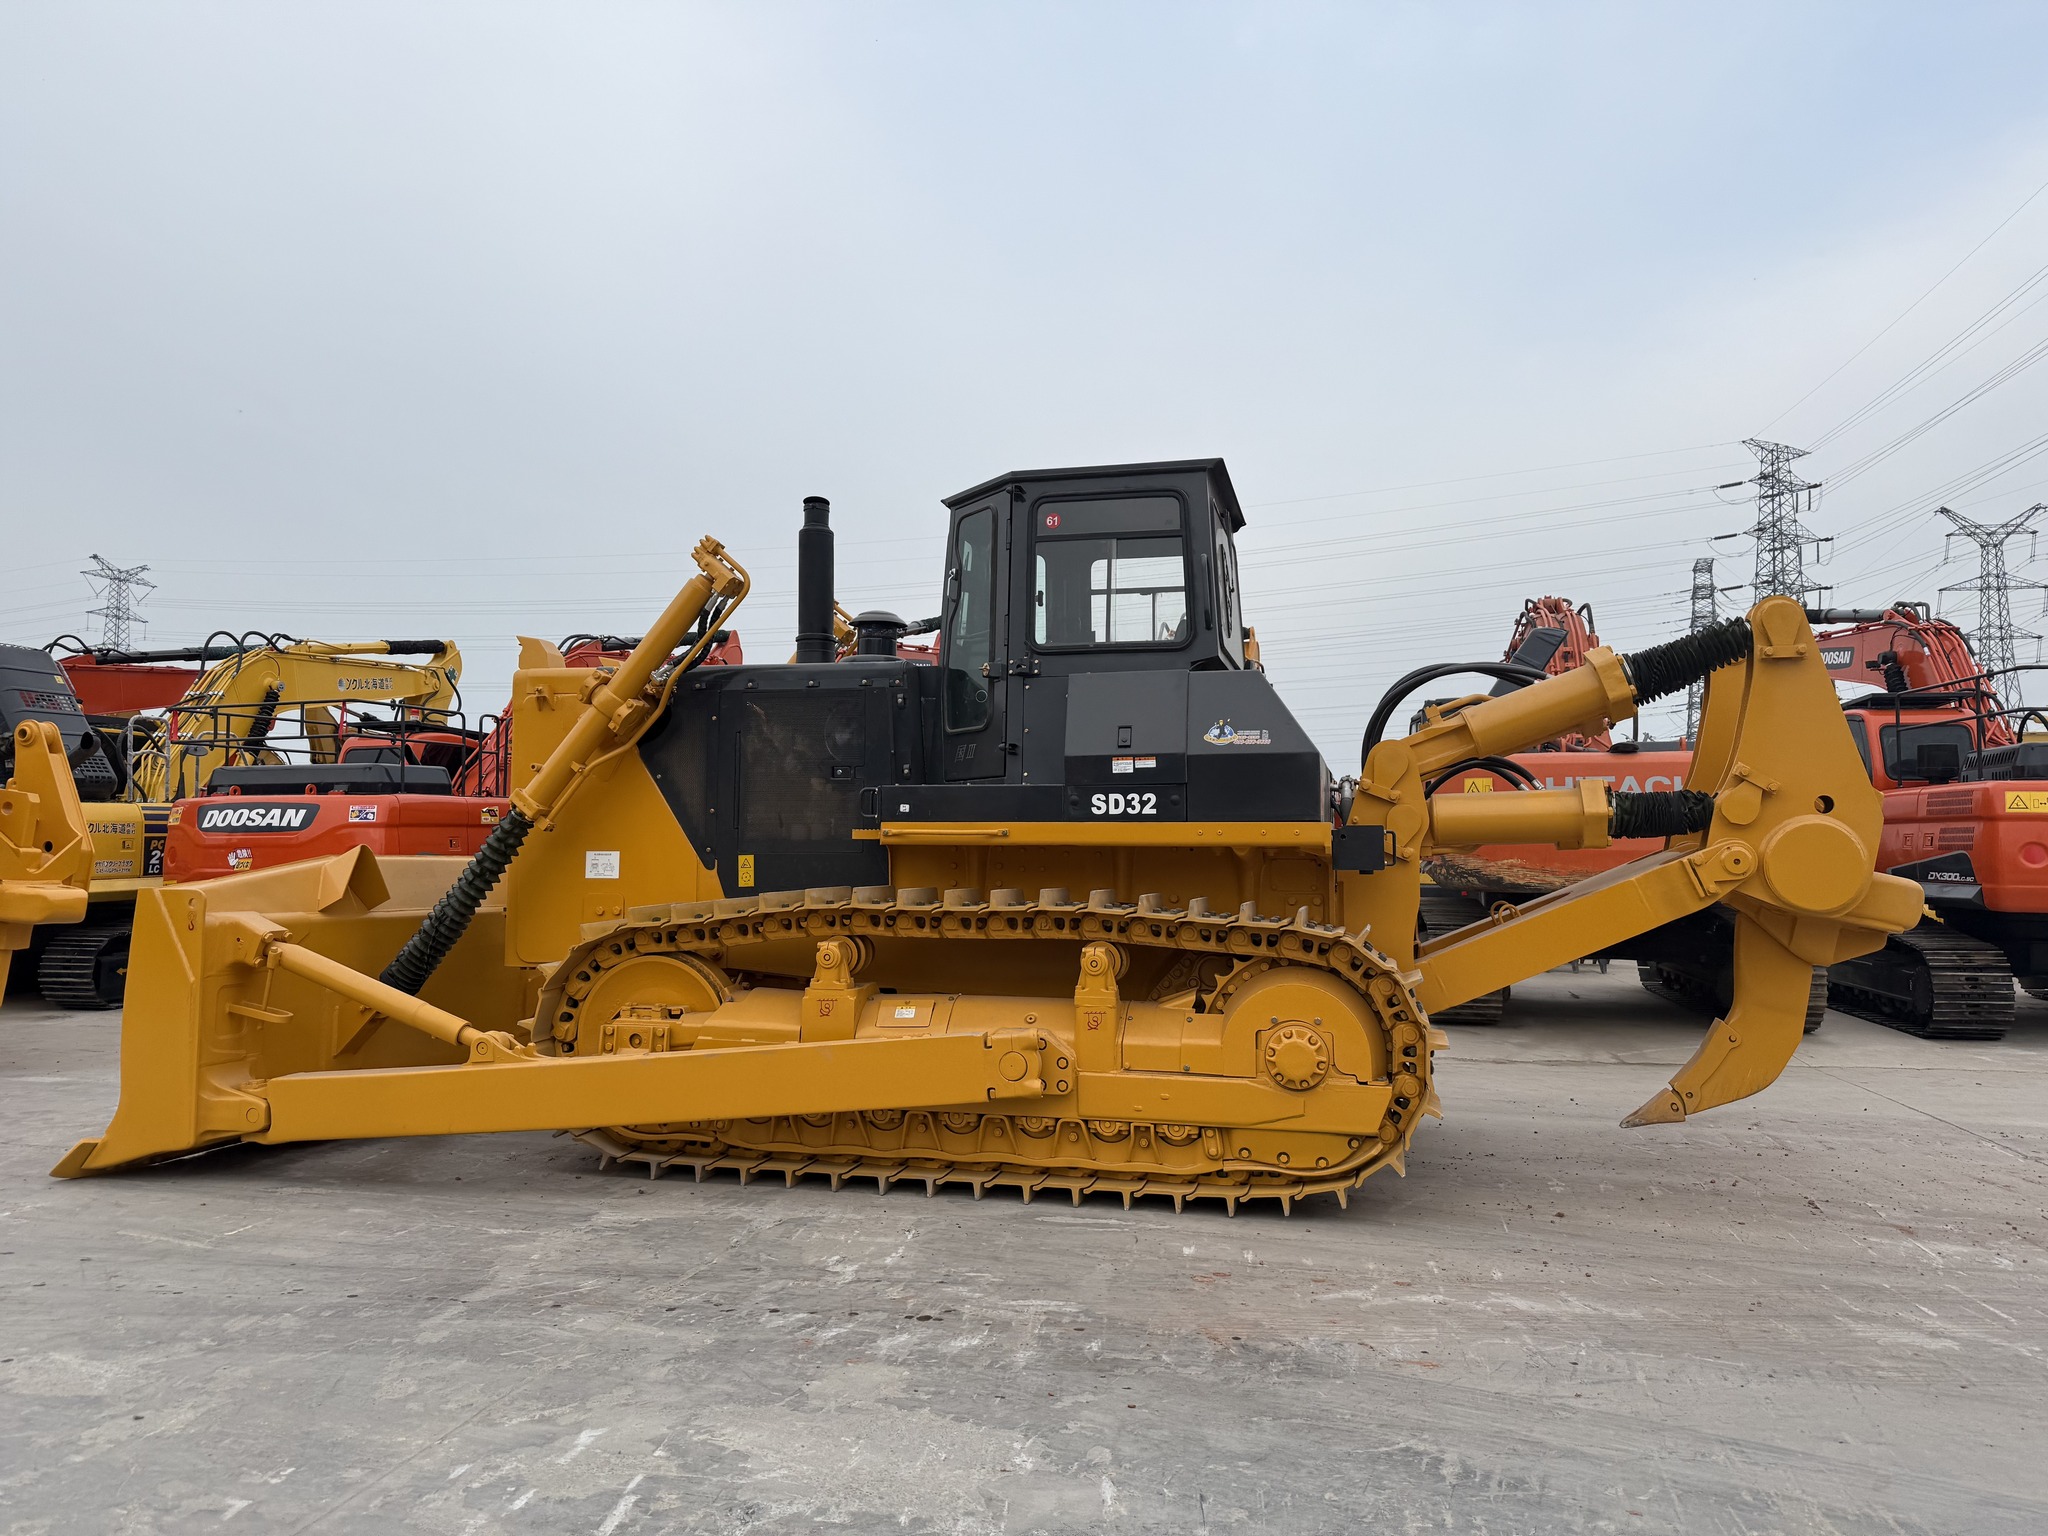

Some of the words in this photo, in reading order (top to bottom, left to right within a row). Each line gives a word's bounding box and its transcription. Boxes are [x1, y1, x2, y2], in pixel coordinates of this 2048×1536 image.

[1046, 516, 1058, 526] 61
[1091, 793, 1157, 815] SD32
[201, 808, 307, 828] DOOSAN
[149, 850, 164, 864] 2
[148, 865, 161, 874] LC
